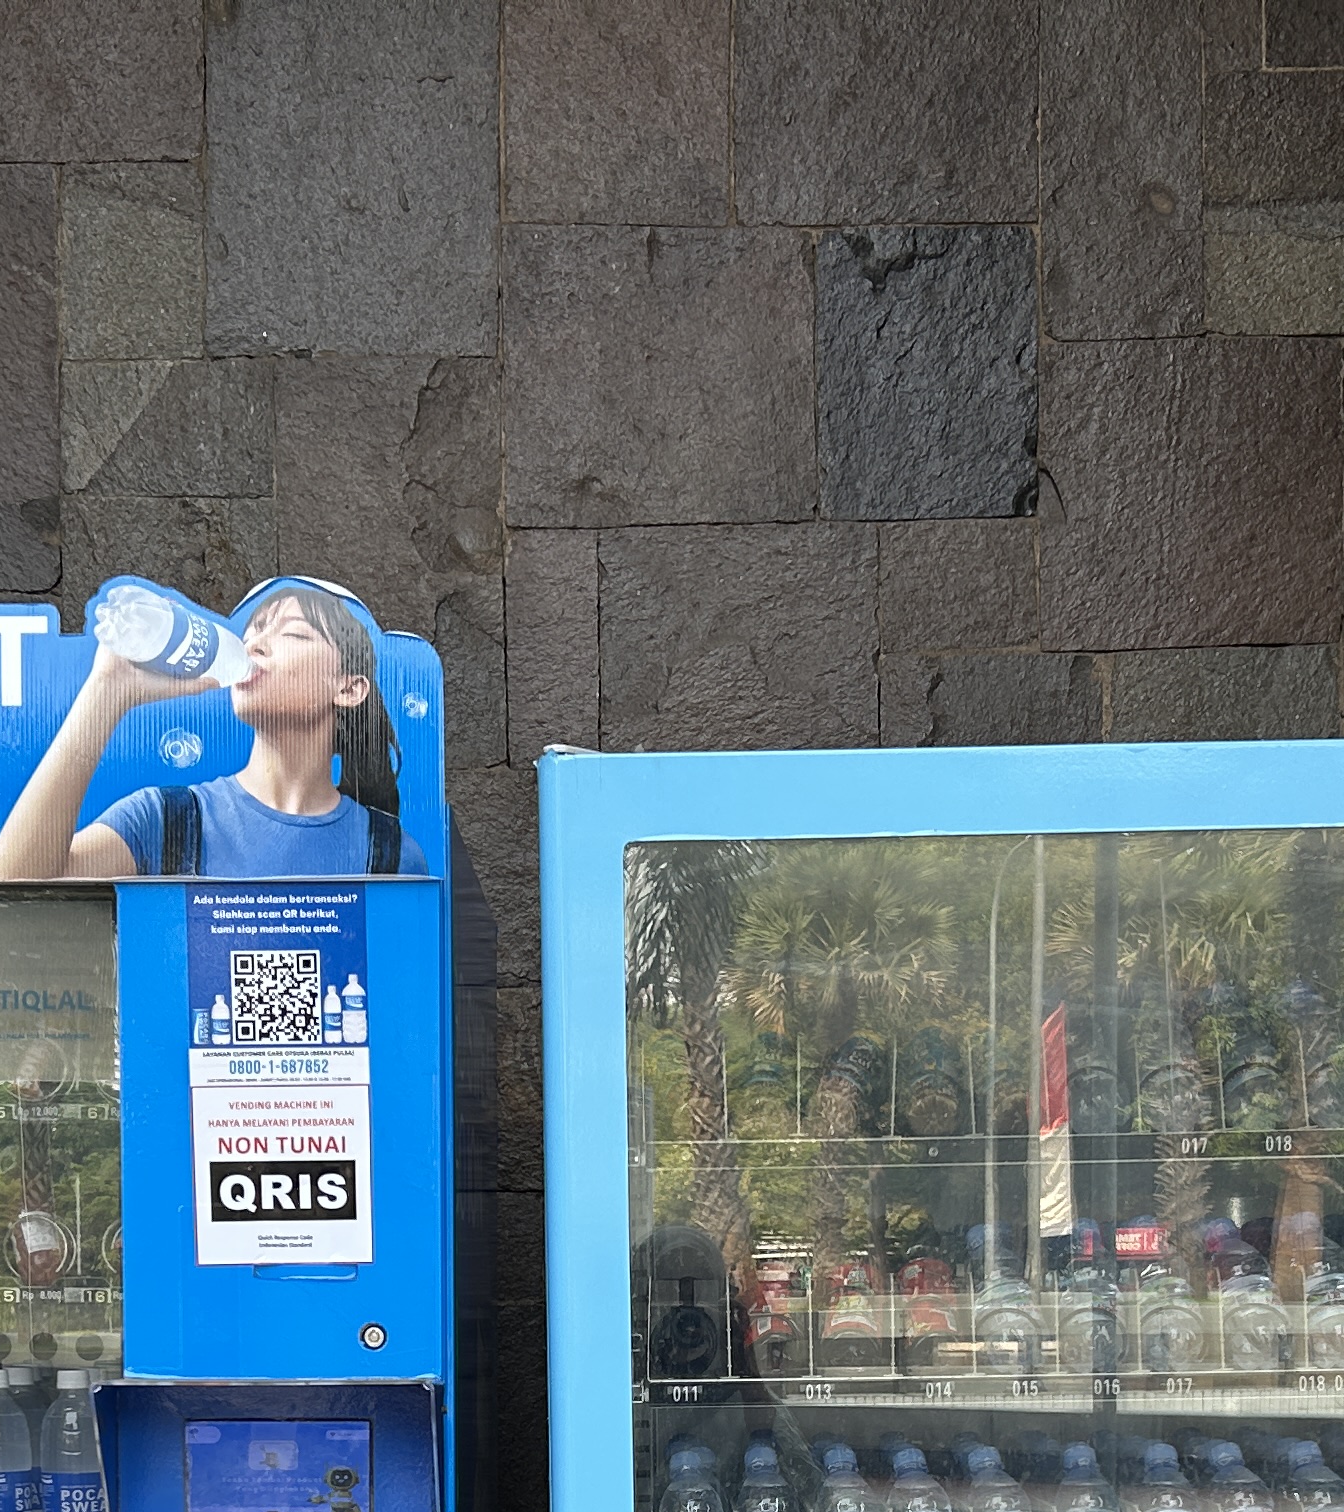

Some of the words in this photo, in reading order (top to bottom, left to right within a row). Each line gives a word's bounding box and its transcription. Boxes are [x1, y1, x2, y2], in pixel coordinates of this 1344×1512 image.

[165, 739, 200, 759] ION
[193, 895, 214, 905] Ada
[215, 894, 255, 905] kendala
[257, 894, 287, 905] dalam
[289, 893, 358, 905] bertransaksi?
[212, 909, 256, 920] Silahkan
[258, 911, 281, 919] scan
[282, 909, 298, 919] QR
[211, 924, 235, 934] kami
[237, 924, 258, 936] siap
[260, 924, 312, 934] membantu
[229, 1058, 329, 1075] 0800-1-687852
[228, 1100, 273, 1111] VENDING
[274, 1100, 318, 1110] MACHINE
[320, 1100, 334, 1110] INI
[208, 1118, 241, 1129] HANYA
[242, 1118, 290, 1128] MELAYANI
[291, 1117, 355, 1128] PEMBAYARAN
[217, 1136, 269, 1155] NON
[275, 1135, 346, 1154] TUNAI
[1265, 1135, 1293, 1153] 018
[218, 1172, 349, 1214] QRIS
[672, 1385, 700, 1403] 011
[805, 1383, 832, 1401] 013
[1093, 1379, 1120, 1396] 016
[60, 1489, 106, 1502] POCA
